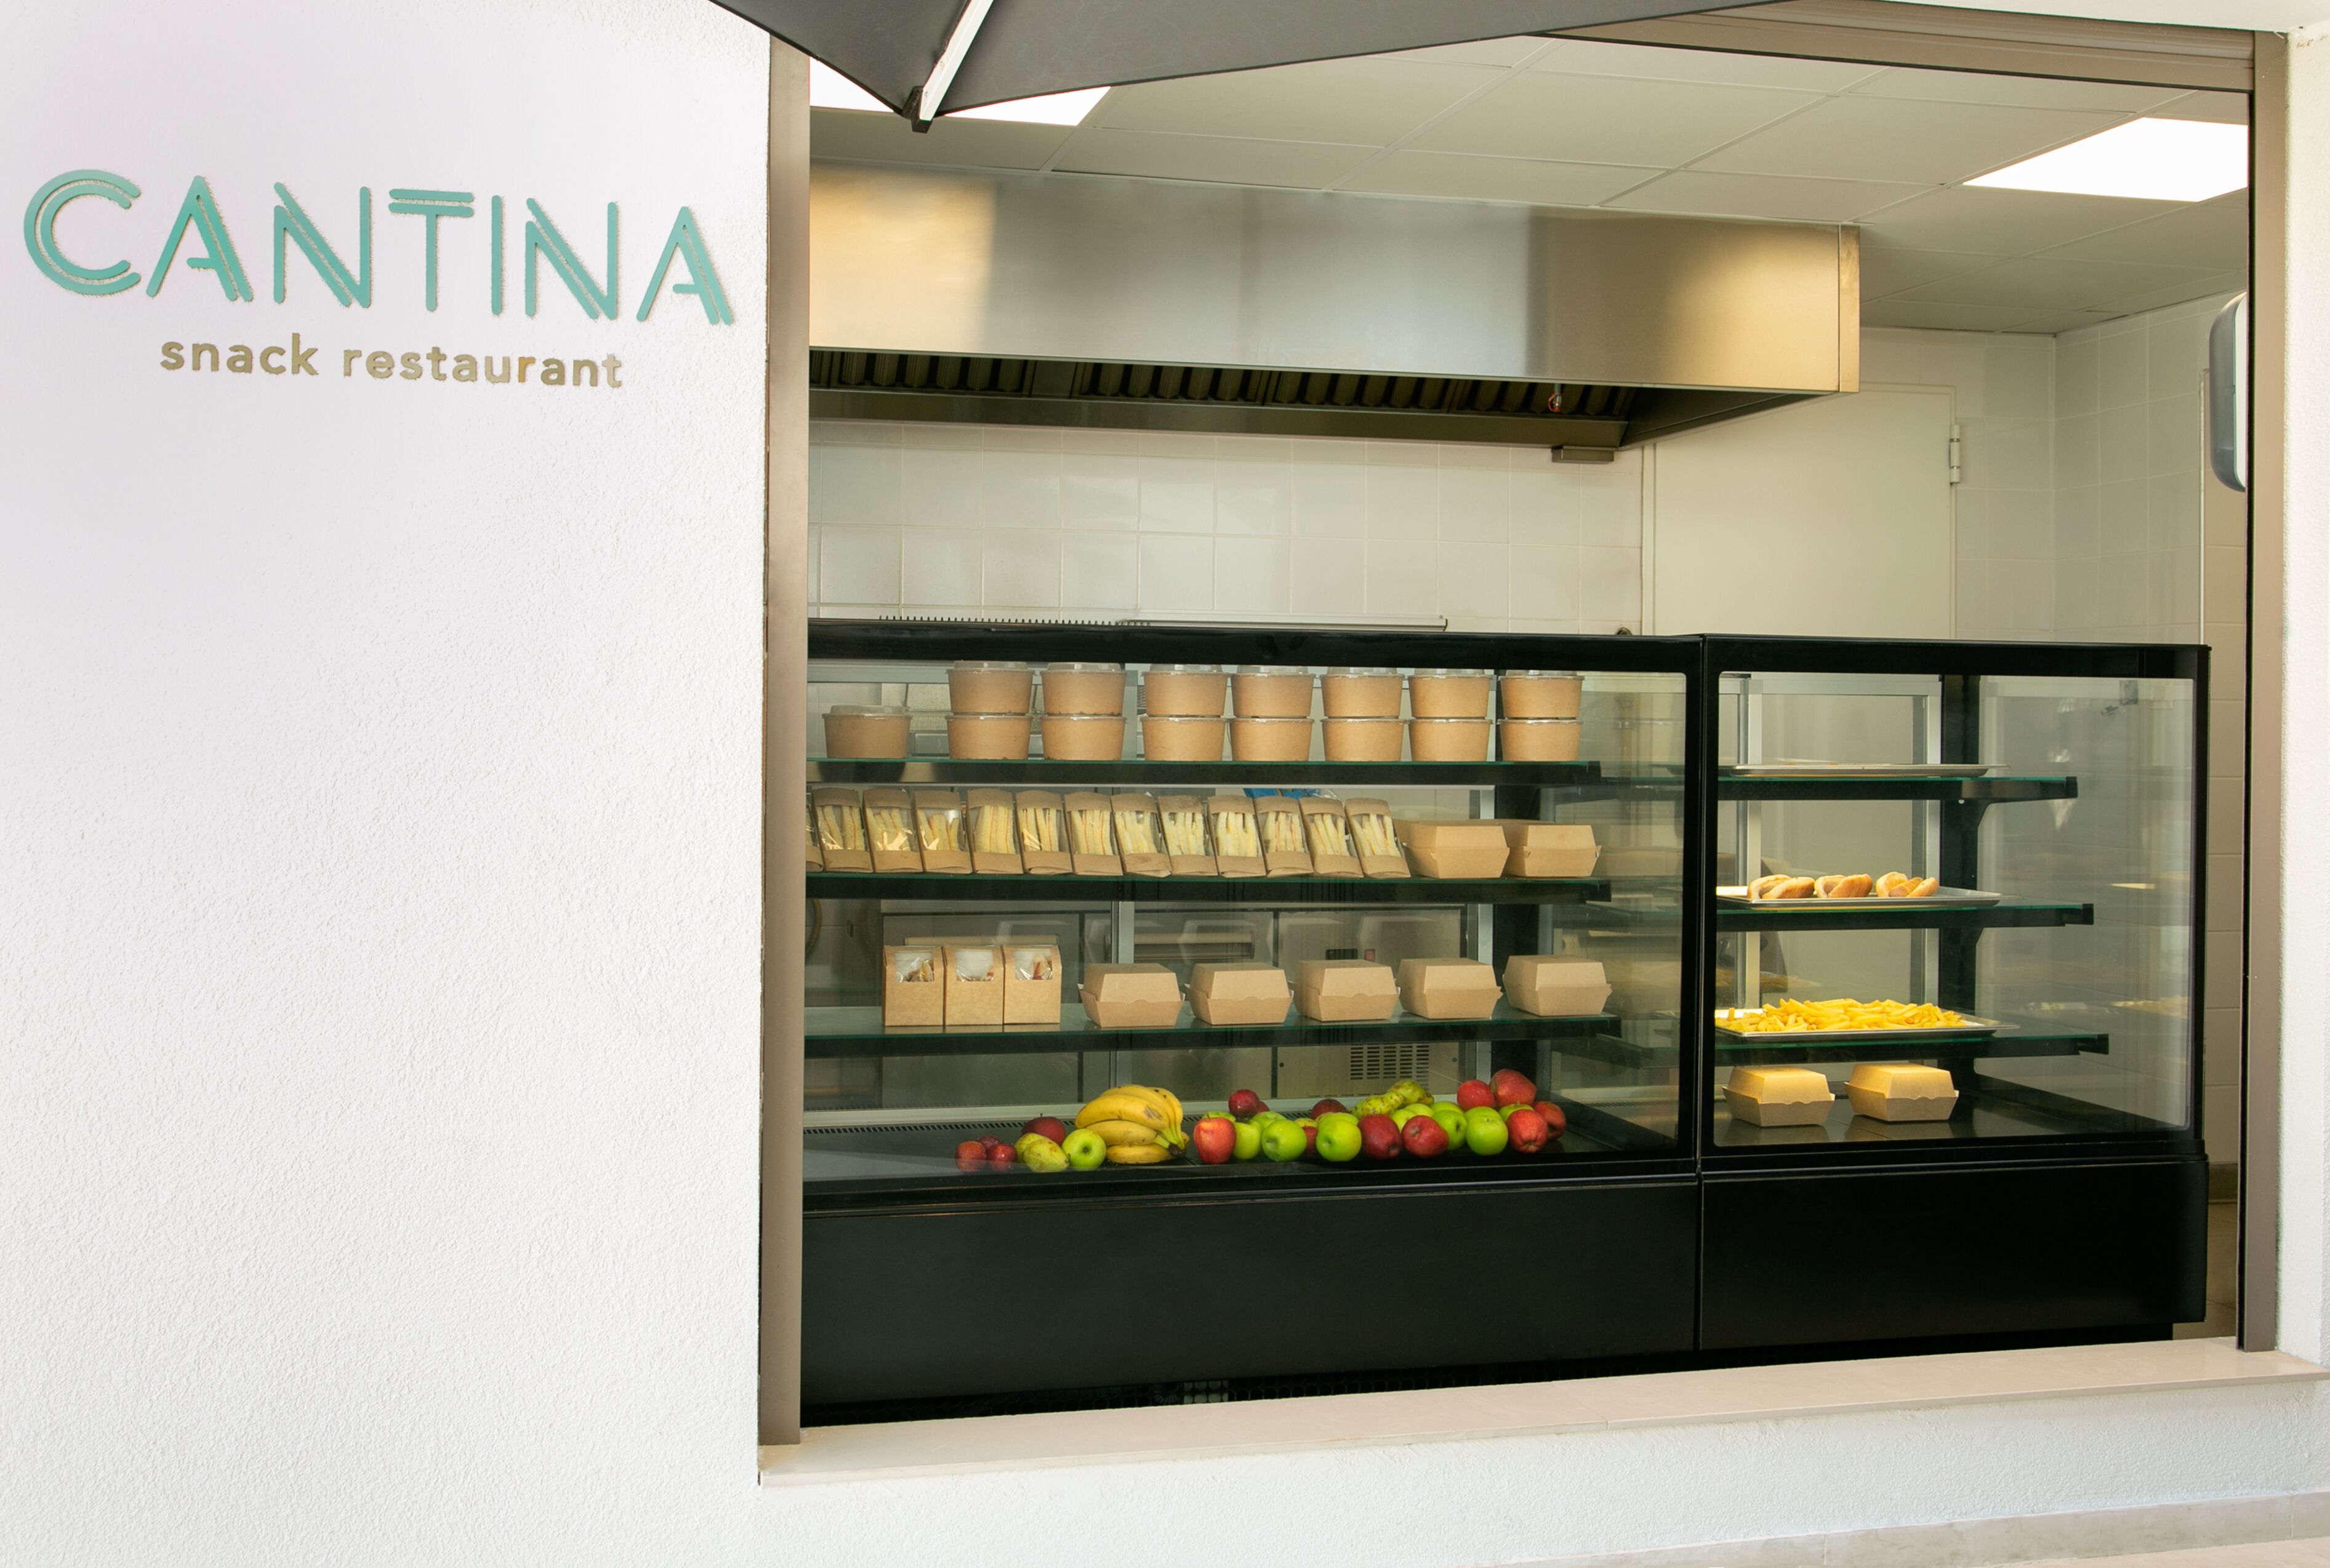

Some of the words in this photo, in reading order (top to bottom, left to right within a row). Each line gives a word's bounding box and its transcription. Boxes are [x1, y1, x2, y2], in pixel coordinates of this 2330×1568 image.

[24, 169, 732, 325] CANTINA
[160, 333, 319, 376] snack
[343, 346, 622, 388] restaurant
